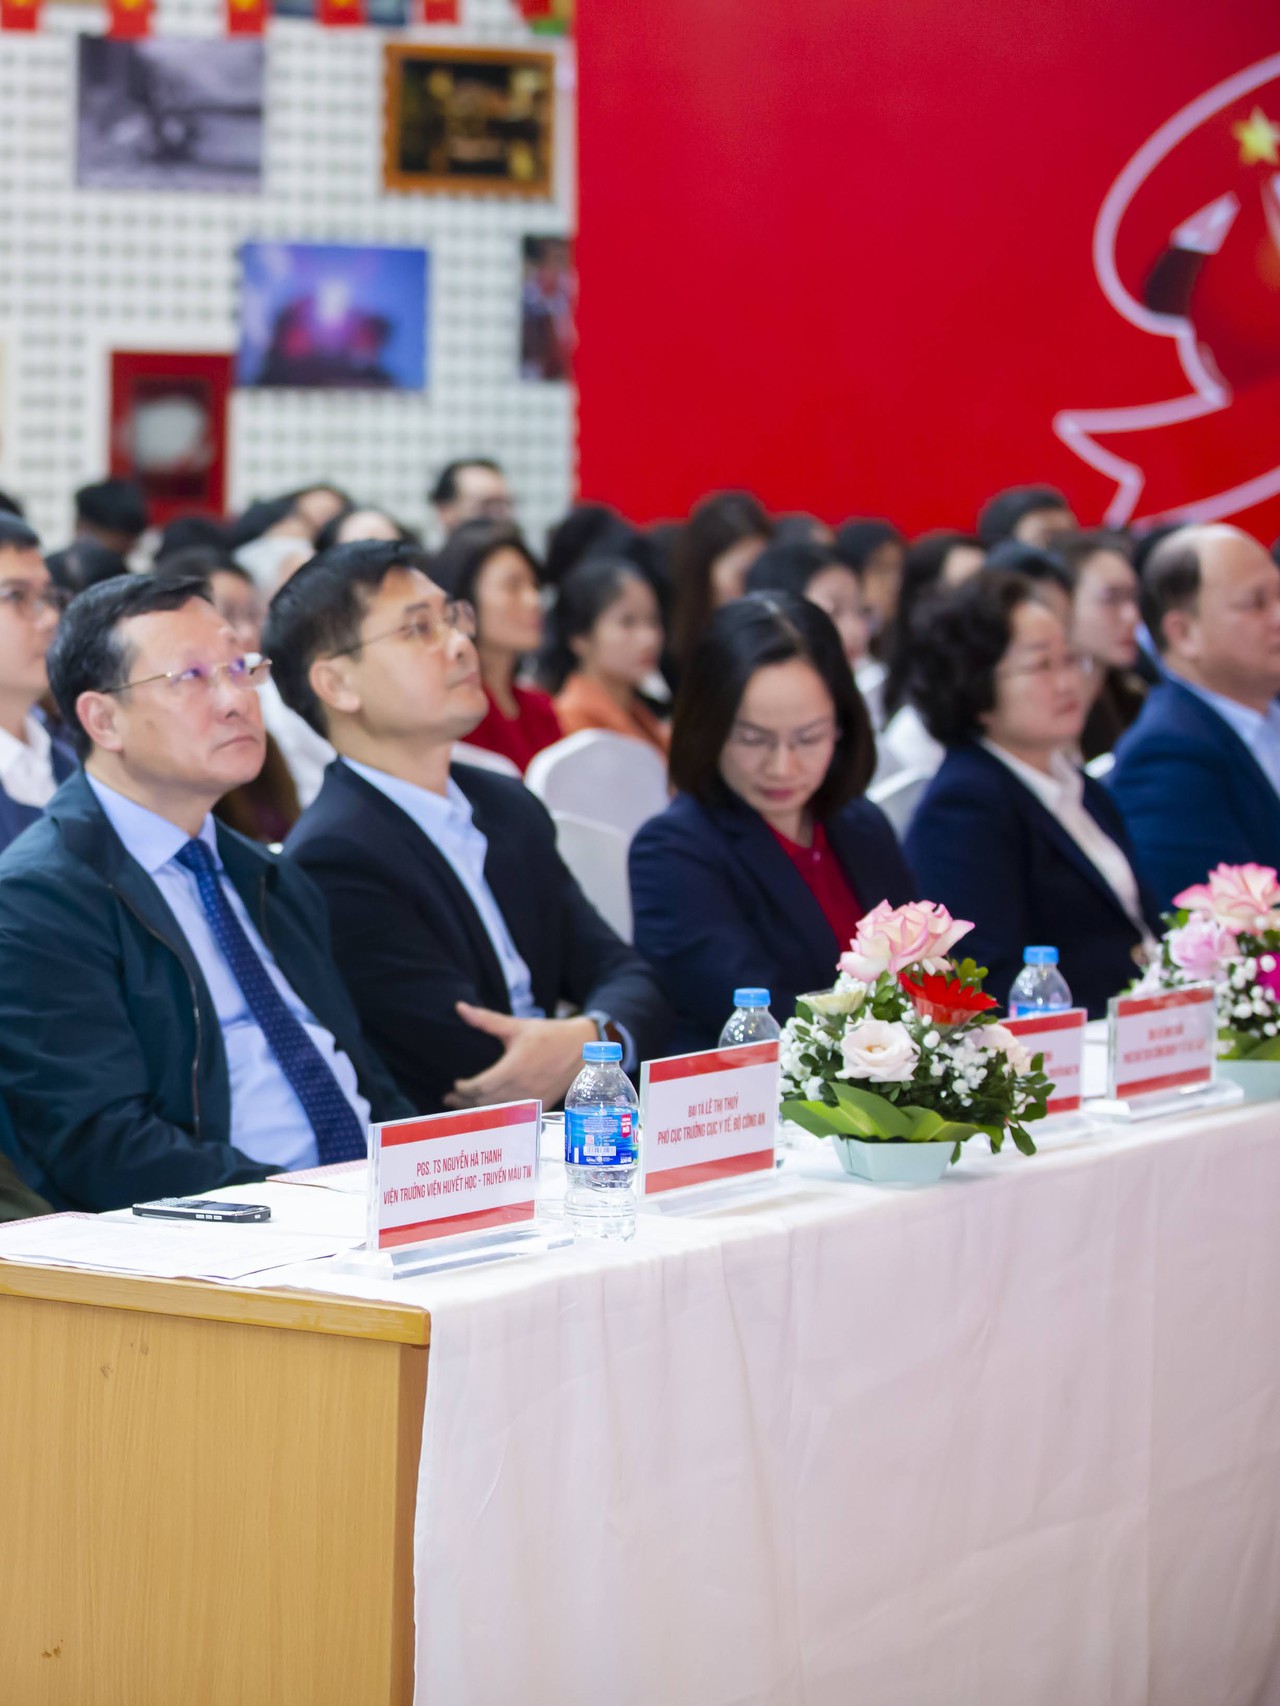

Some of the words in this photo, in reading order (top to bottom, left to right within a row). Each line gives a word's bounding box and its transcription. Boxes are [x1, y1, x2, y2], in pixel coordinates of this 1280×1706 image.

[416, 1160, 432, 1177] PGS.
[433, 1159, 442, 1174] TS
[443, 1149, 469, 1173] NGUYỄN
[470, 1149, 479, 1167] HÀ
[480, 1148, 502, 1166] THANH
[383, 1186, 399, 1207] VIỆN
[443, 1173, 464, 1195] HUYẾT
[464, 1174, 477, 1192] HỌC
[523, 1164, 533, 1179] TW
